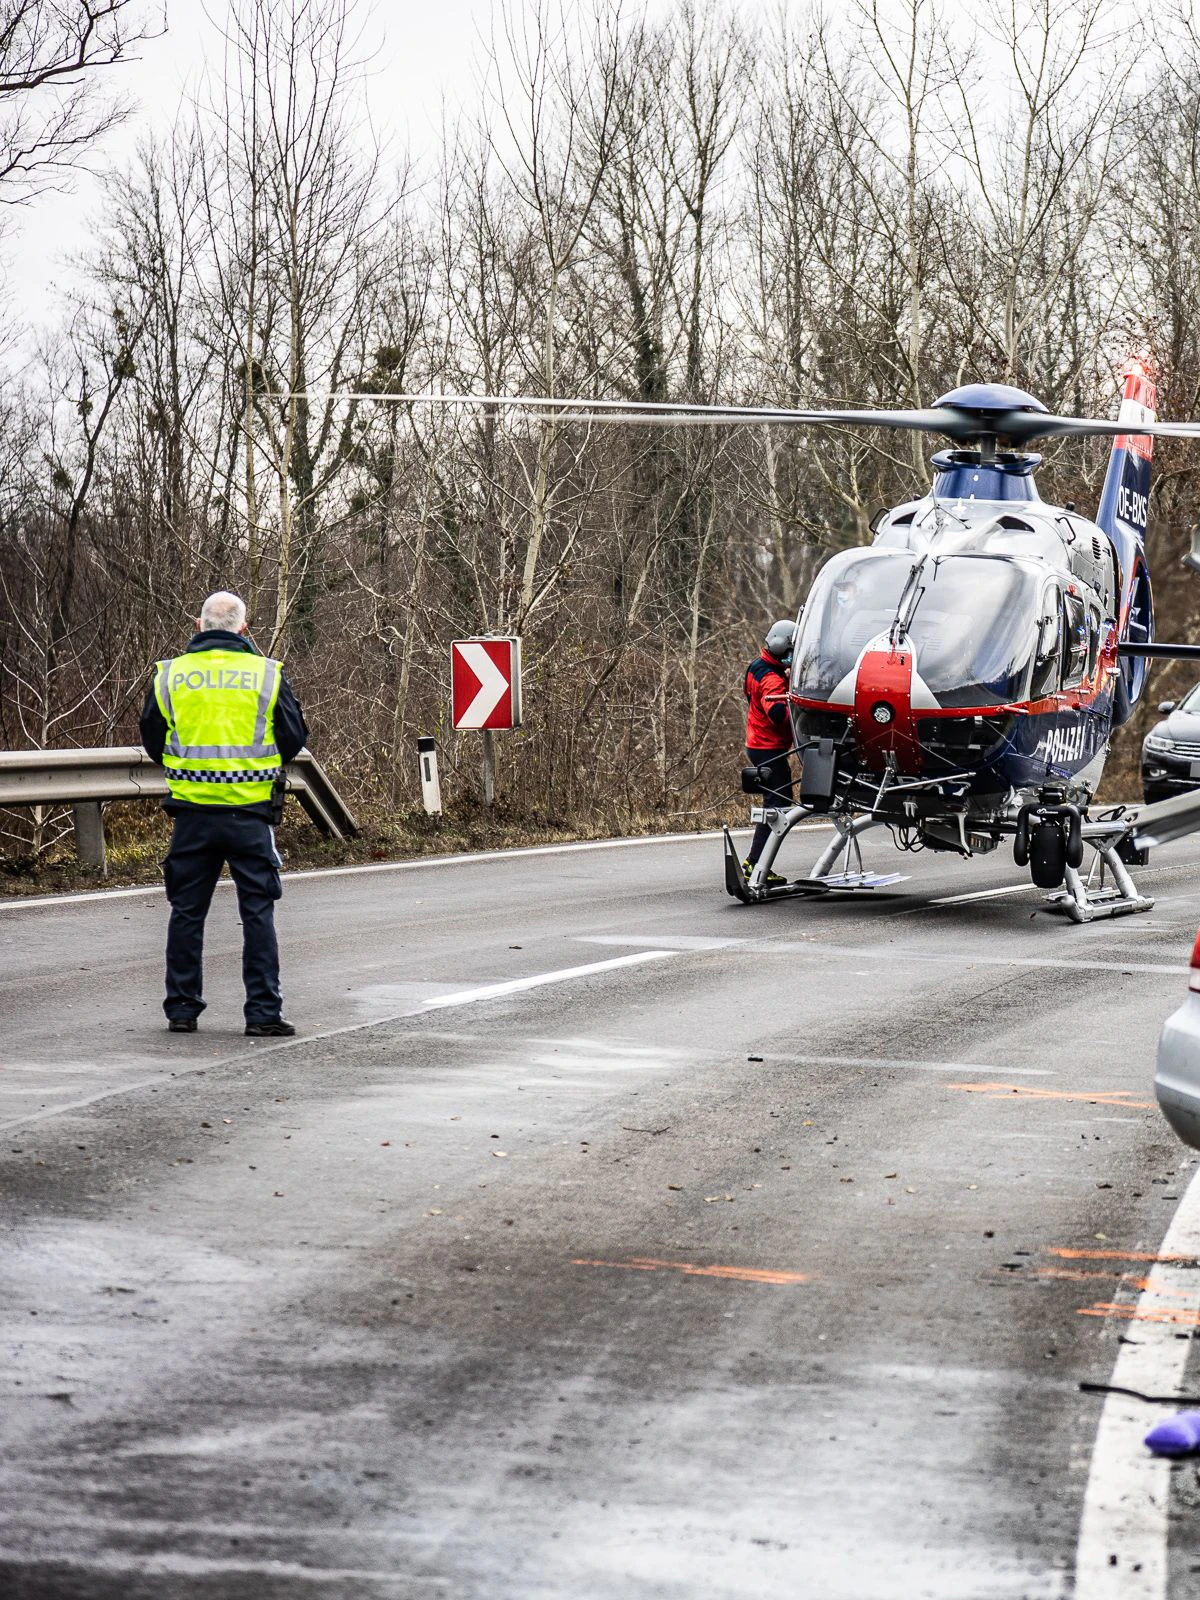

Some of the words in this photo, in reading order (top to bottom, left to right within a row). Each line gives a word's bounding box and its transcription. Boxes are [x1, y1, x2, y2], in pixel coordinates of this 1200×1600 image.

[1118, 485, 1148, 528] OE-BXS
[173, 670, 258, 691] POLIZEI
[1043, 725, 1086, 764] POLIZEI
